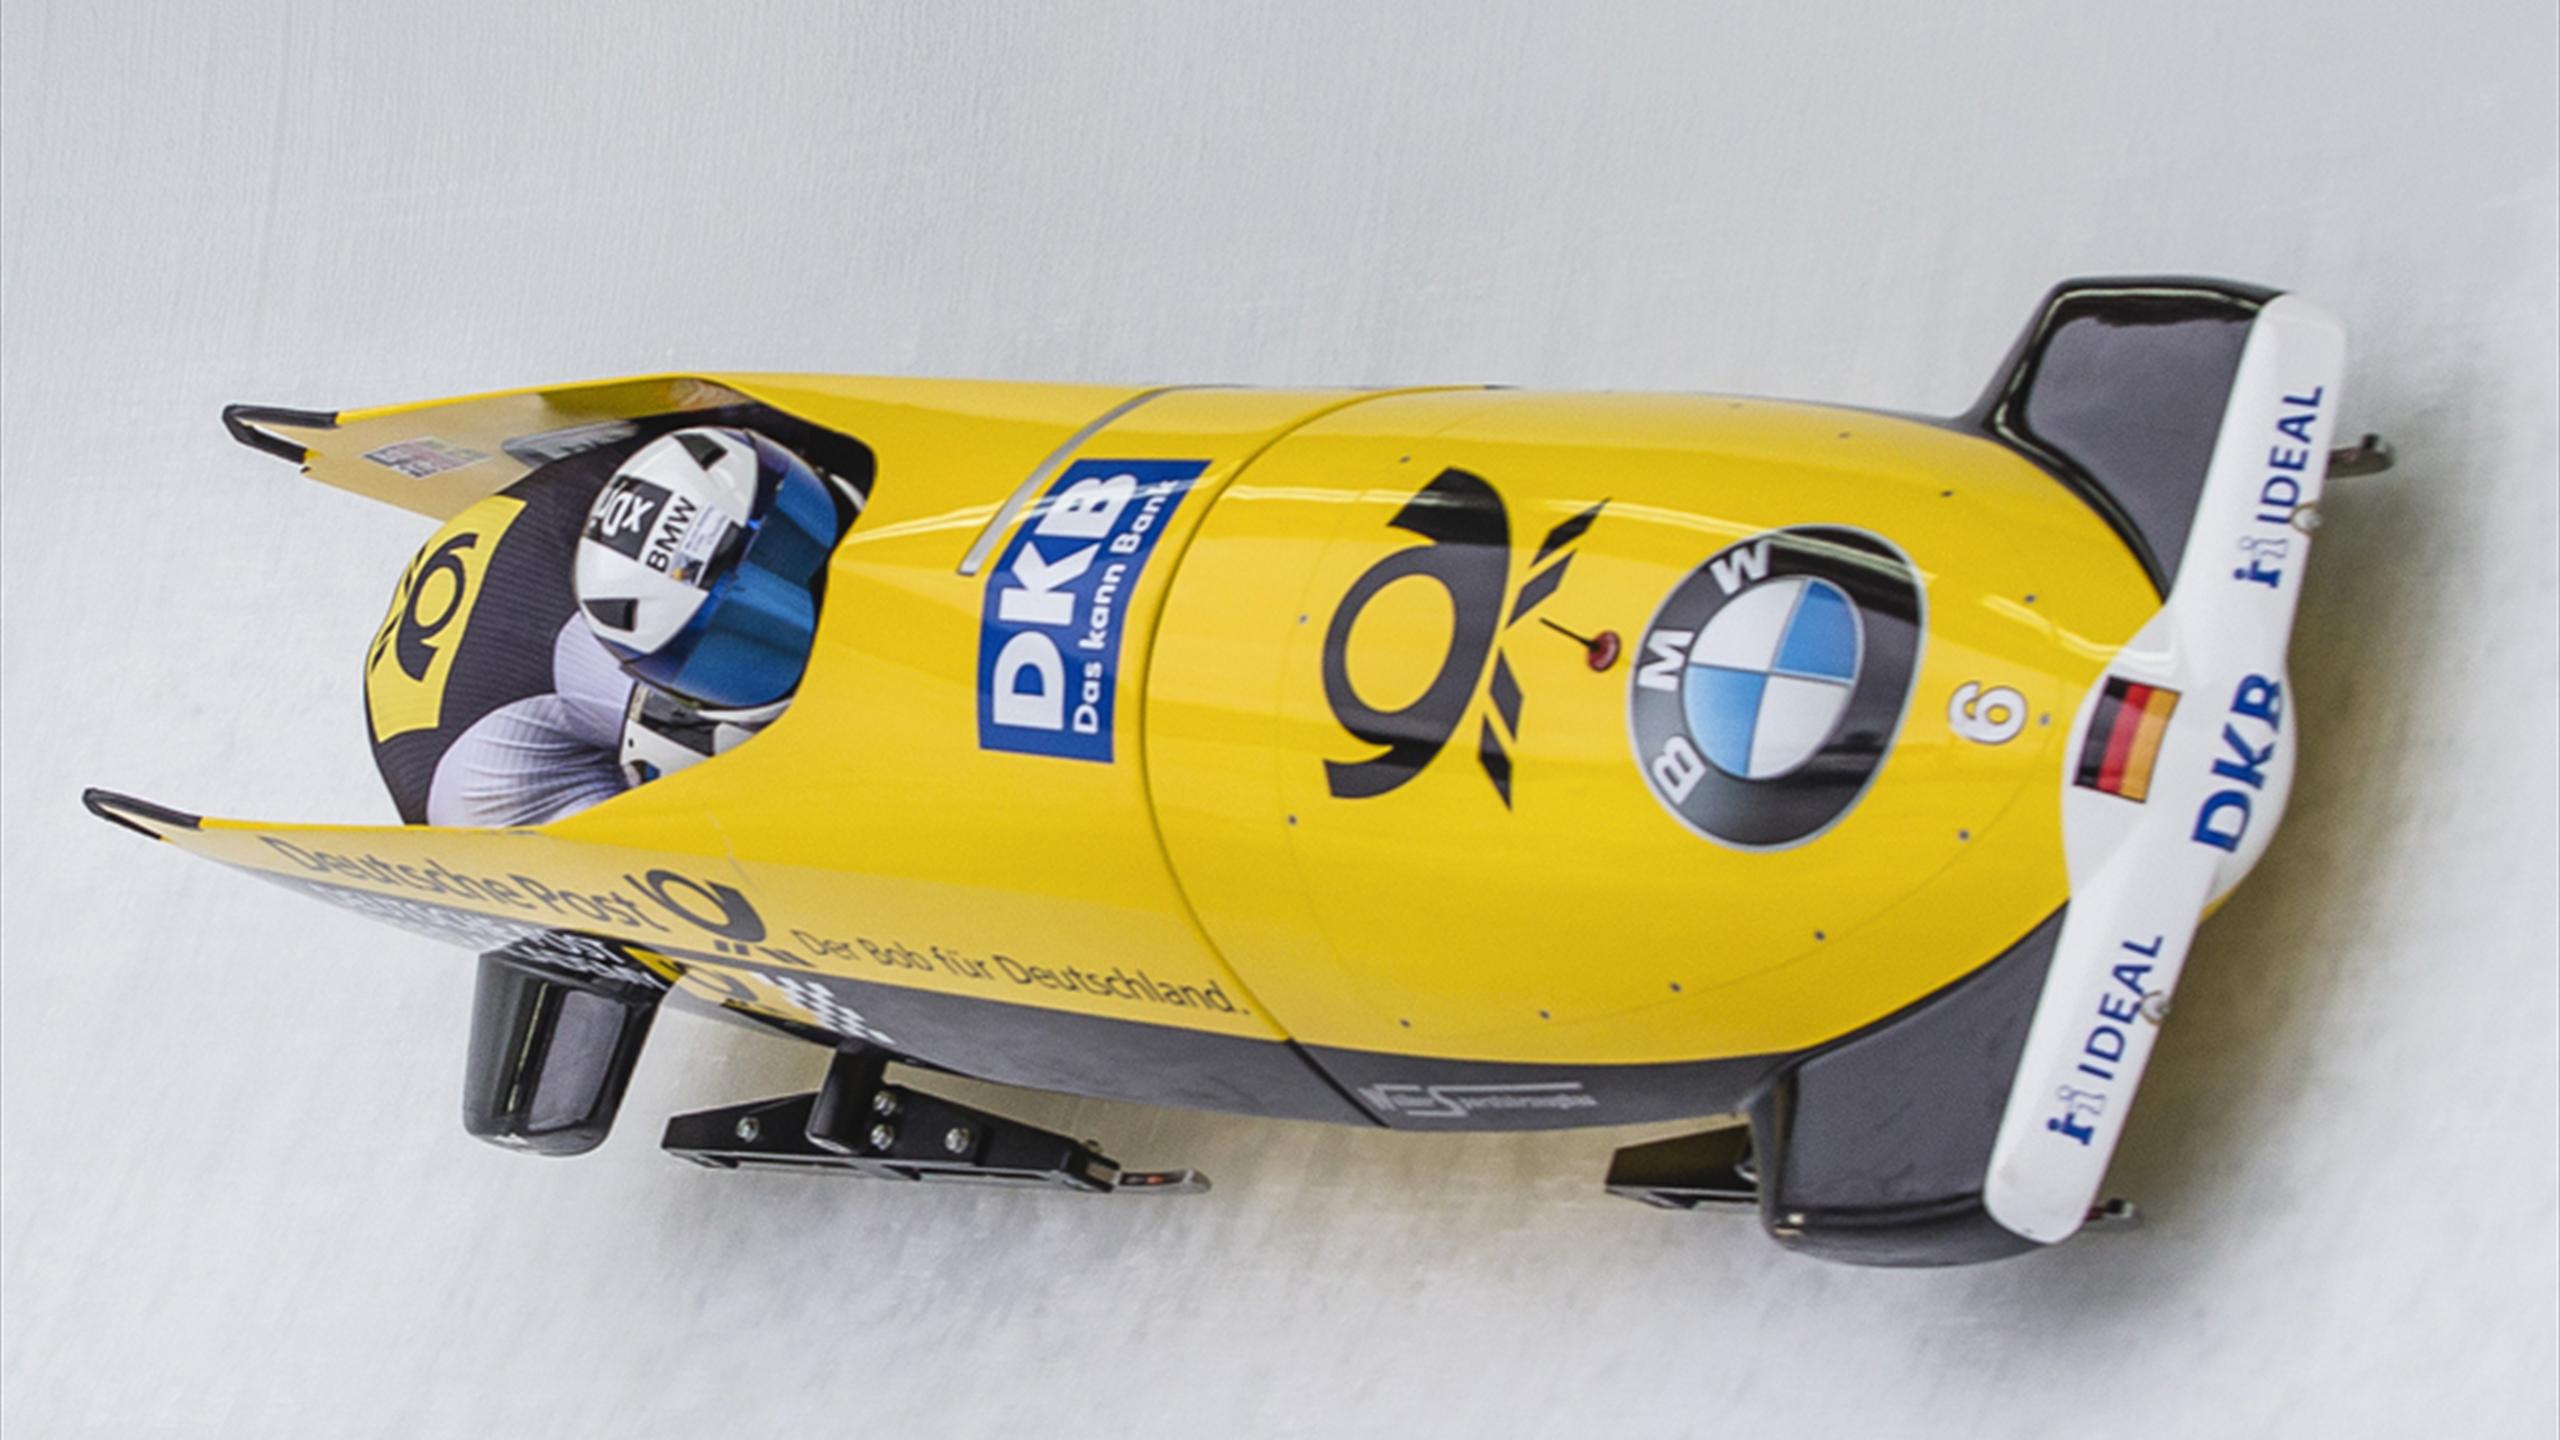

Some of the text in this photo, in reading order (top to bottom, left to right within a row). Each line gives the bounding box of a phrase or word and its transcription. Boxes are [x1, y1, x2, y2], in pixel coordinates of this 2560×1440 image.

[2257, 385, 2324, 526] IDEAL
[645, 495, 698, 574] BMW
[993, 473, 1138, 731] DKB
[1071, 479, 1180, 734] Das kann Bank
[1637, 539, 1773, 805] BMW
[2191, 673, 2282, 853] DKB
[257, 834, 538, 911] Deutsche
[506, 873, 671, 933] Post
[790, 928, 1250, 1015] Der Bob für Deutschland.
[2077, 932, 2164, 1081] IDEAL
